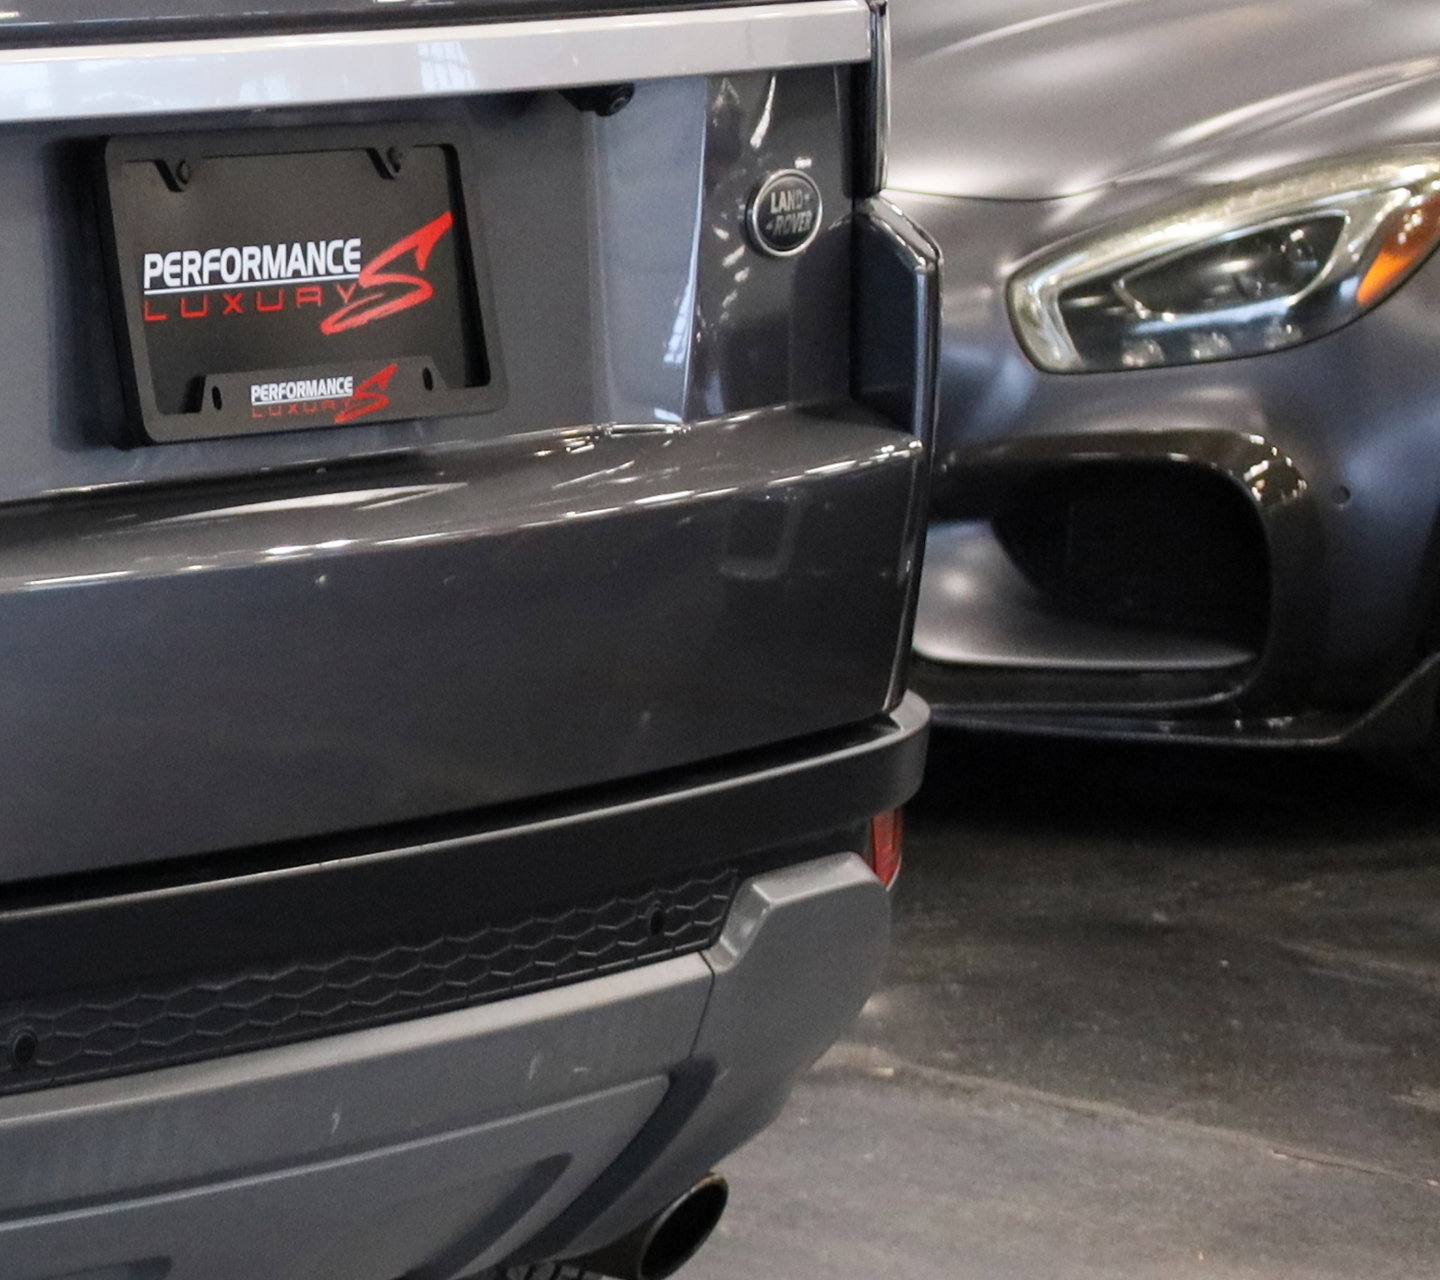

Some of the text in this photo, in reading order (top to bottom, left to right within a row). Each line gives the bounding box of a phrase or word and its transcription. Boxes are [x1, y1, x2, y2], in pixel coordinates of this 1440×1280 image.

[770, 189, 803, 214] LAND
[772, 211, 813, 236] ROVER
[144, 238, 361, 289] PERFORMANCE
[144, 283, 358, 322] LUXURY
[251, 376, 353, 404] PERFORMANCE
